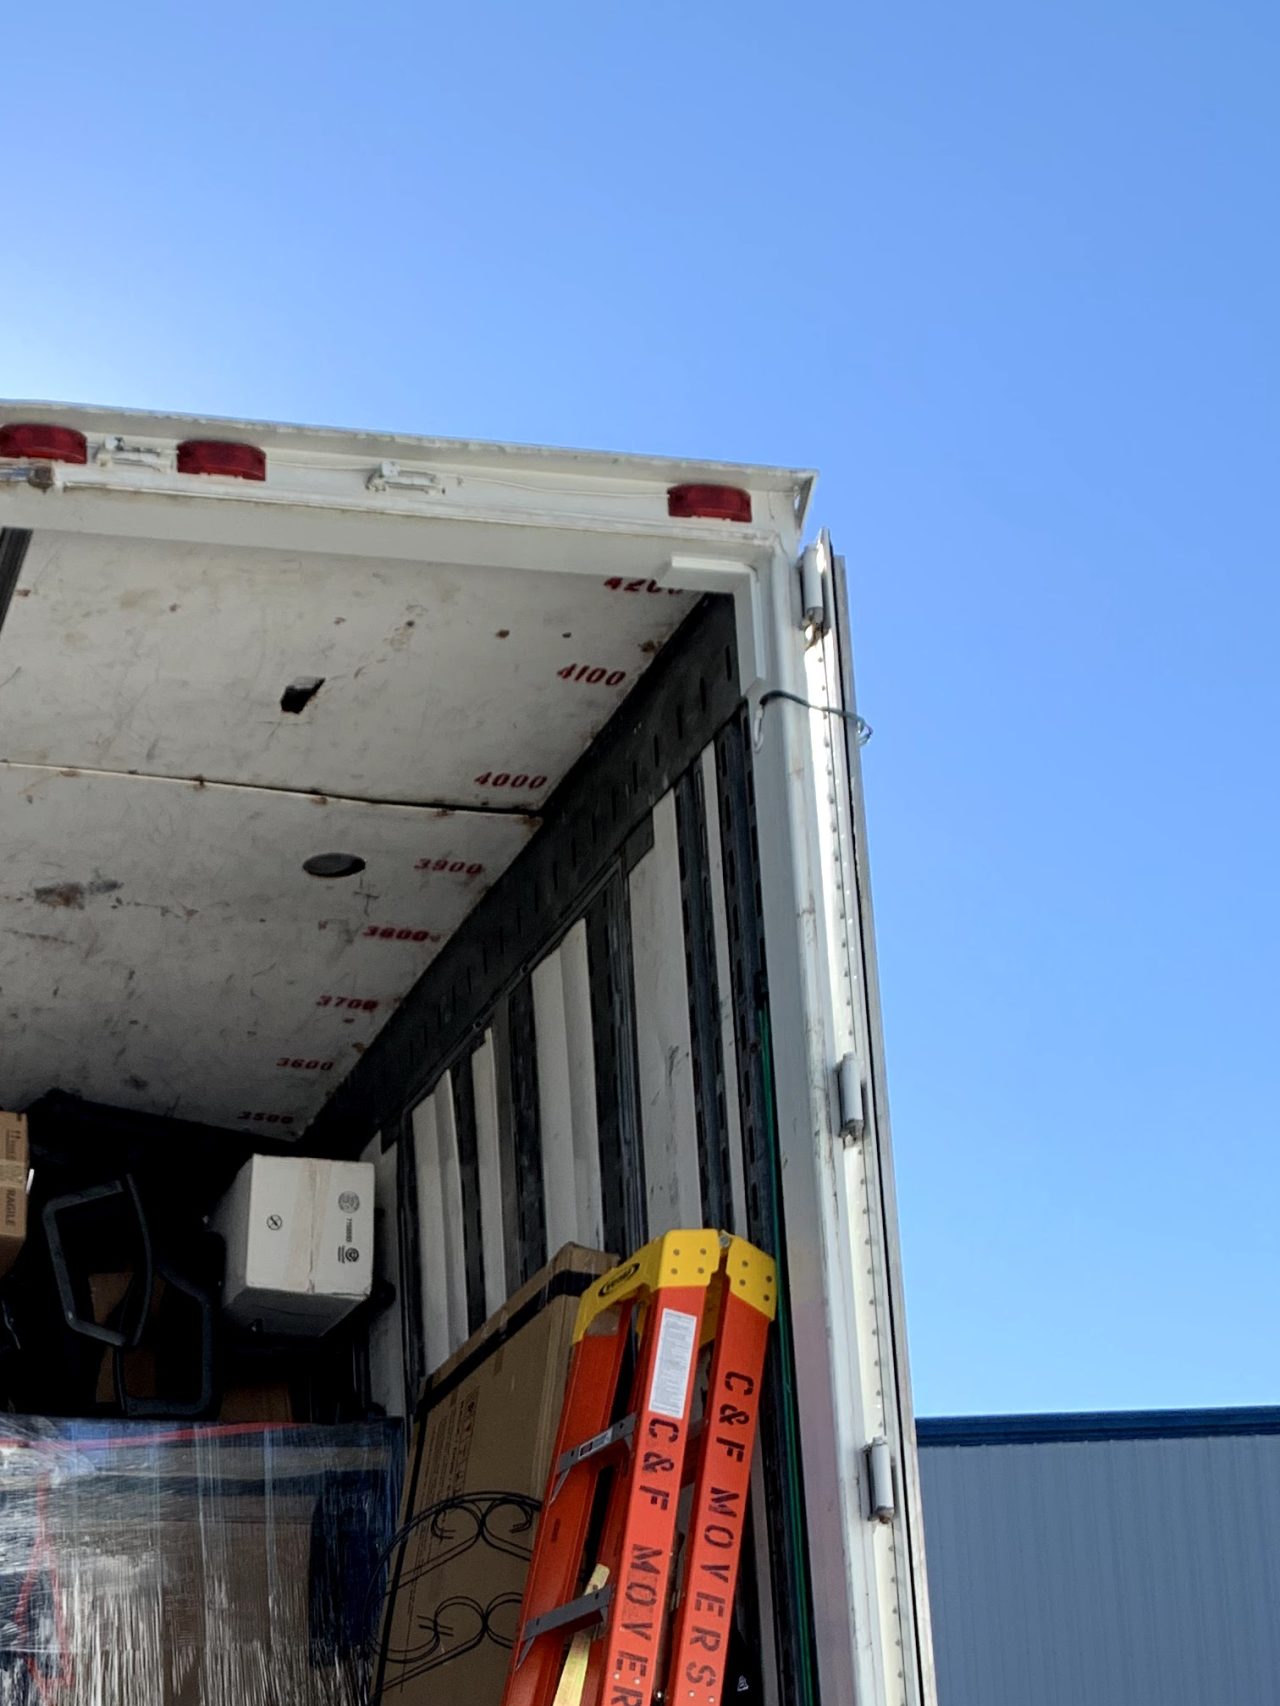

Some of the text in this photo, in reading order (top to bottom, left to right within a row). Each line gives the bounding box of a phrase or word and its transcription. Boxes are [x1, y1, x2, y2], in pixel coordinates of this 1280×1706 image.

[603, 576, 684, 595] 420
[557, 663, 627, 686] 4100
[474, 771, 548, 789] 4000
[414, 858, 483, 875] 3900
[363, 925, 429, 942] 3800
[316, 995, 378, 1012] 3700
[276, 1057, 334, 1071] 3600
[6, 1188, 17, 1227] RAGILE
[640, 1418, 680, 1511] C&F
[685, 1371, 754, 1688] C&F MOVERS
